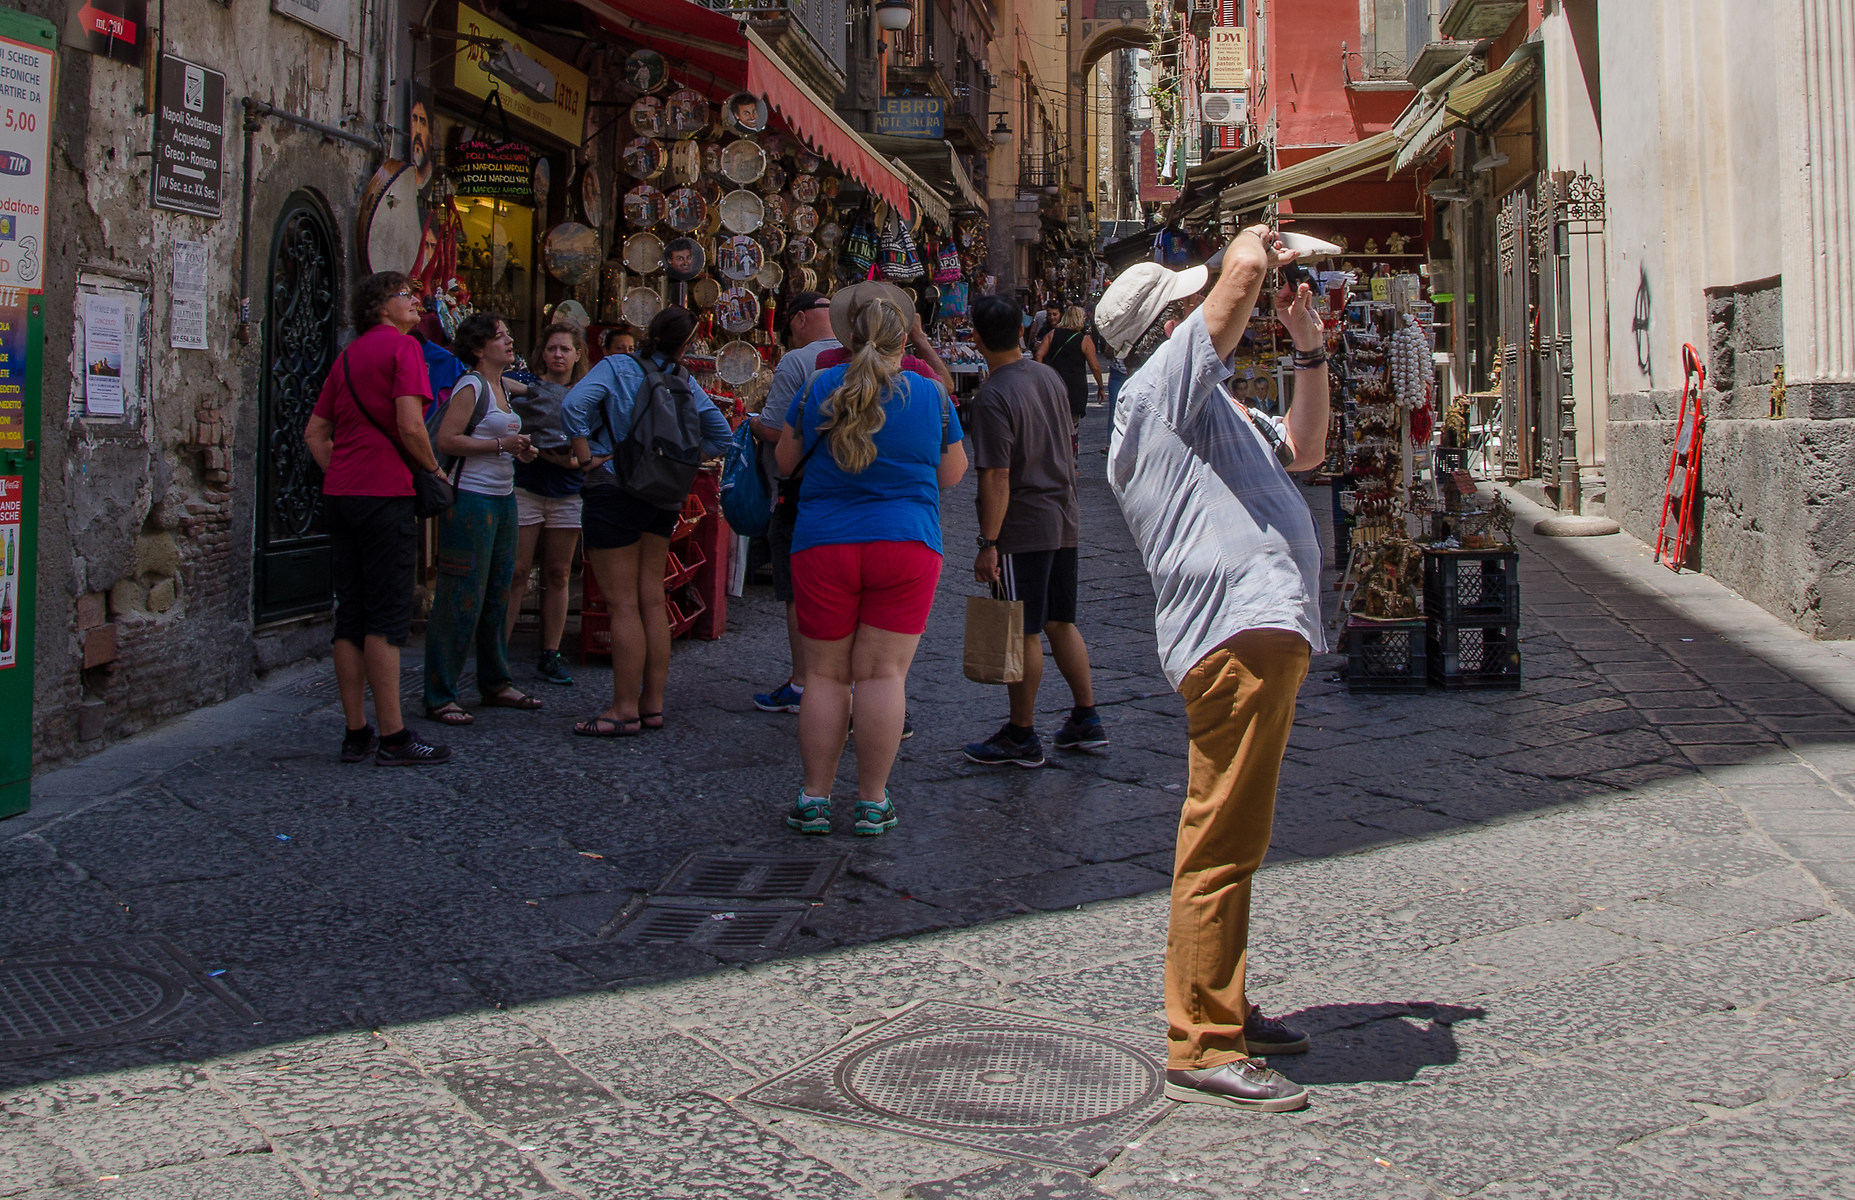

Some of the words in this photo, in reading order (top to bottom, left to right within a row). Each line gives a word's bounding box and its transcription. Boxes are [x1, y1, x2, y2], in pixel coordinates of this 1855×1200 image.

[1216, 33, 1241, 42] DM
[7, 50, 40, 68] SCHEDE
[29, 90, 41, 104] DA
[5, 108, 37, 132] 5,00
[162, 105, 185, 125] Napoli
[185, 112, 223, 136] Sotterranea
[906, 116, 941, 128] SACRA
[172, 127, 211, 150] Acquedotto
[8, 156, 28, 173] TIM
[164, 144, 186, 162] Greco
[190, 150, 218, 170] Romano
[472, 162, 503, 172] NAPOLI
[488, 174, 516, 183] NAPOLI
[169, 177, 183, 192] Sec.
[194, 183, 204, 197] XX
[204, 185, 217, 200] Sec.
[472, 186, 501, 194] NAPOLI
